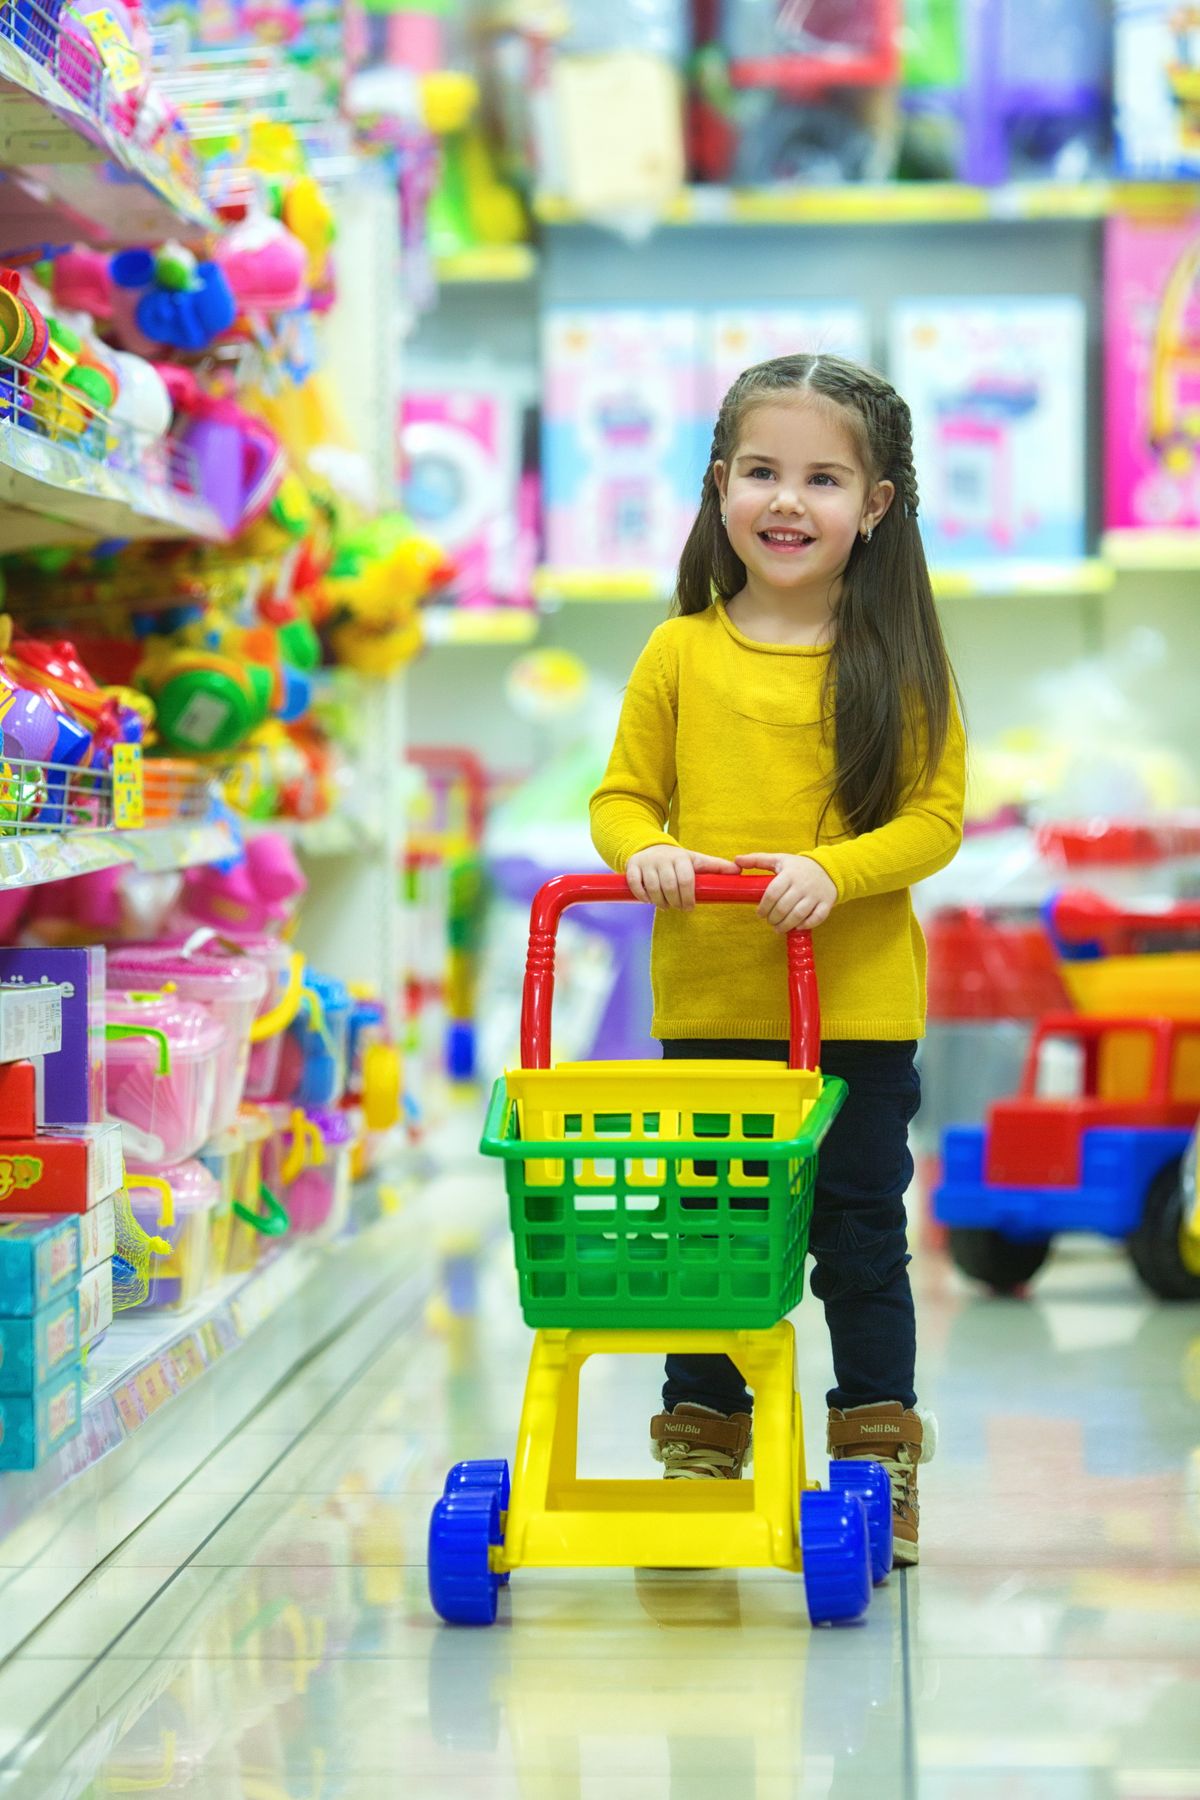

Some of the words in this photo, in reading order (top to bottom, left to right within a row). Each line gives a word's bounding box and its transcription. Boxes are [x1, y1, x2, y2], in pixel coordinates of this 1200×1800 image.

[664, 1423, 684, 1432] Nelli
[685, 1424, 700, 1434] Blu
[860, 1424, 883, 1433] Nelli
[884, 1424, 900, 1433] Blu
